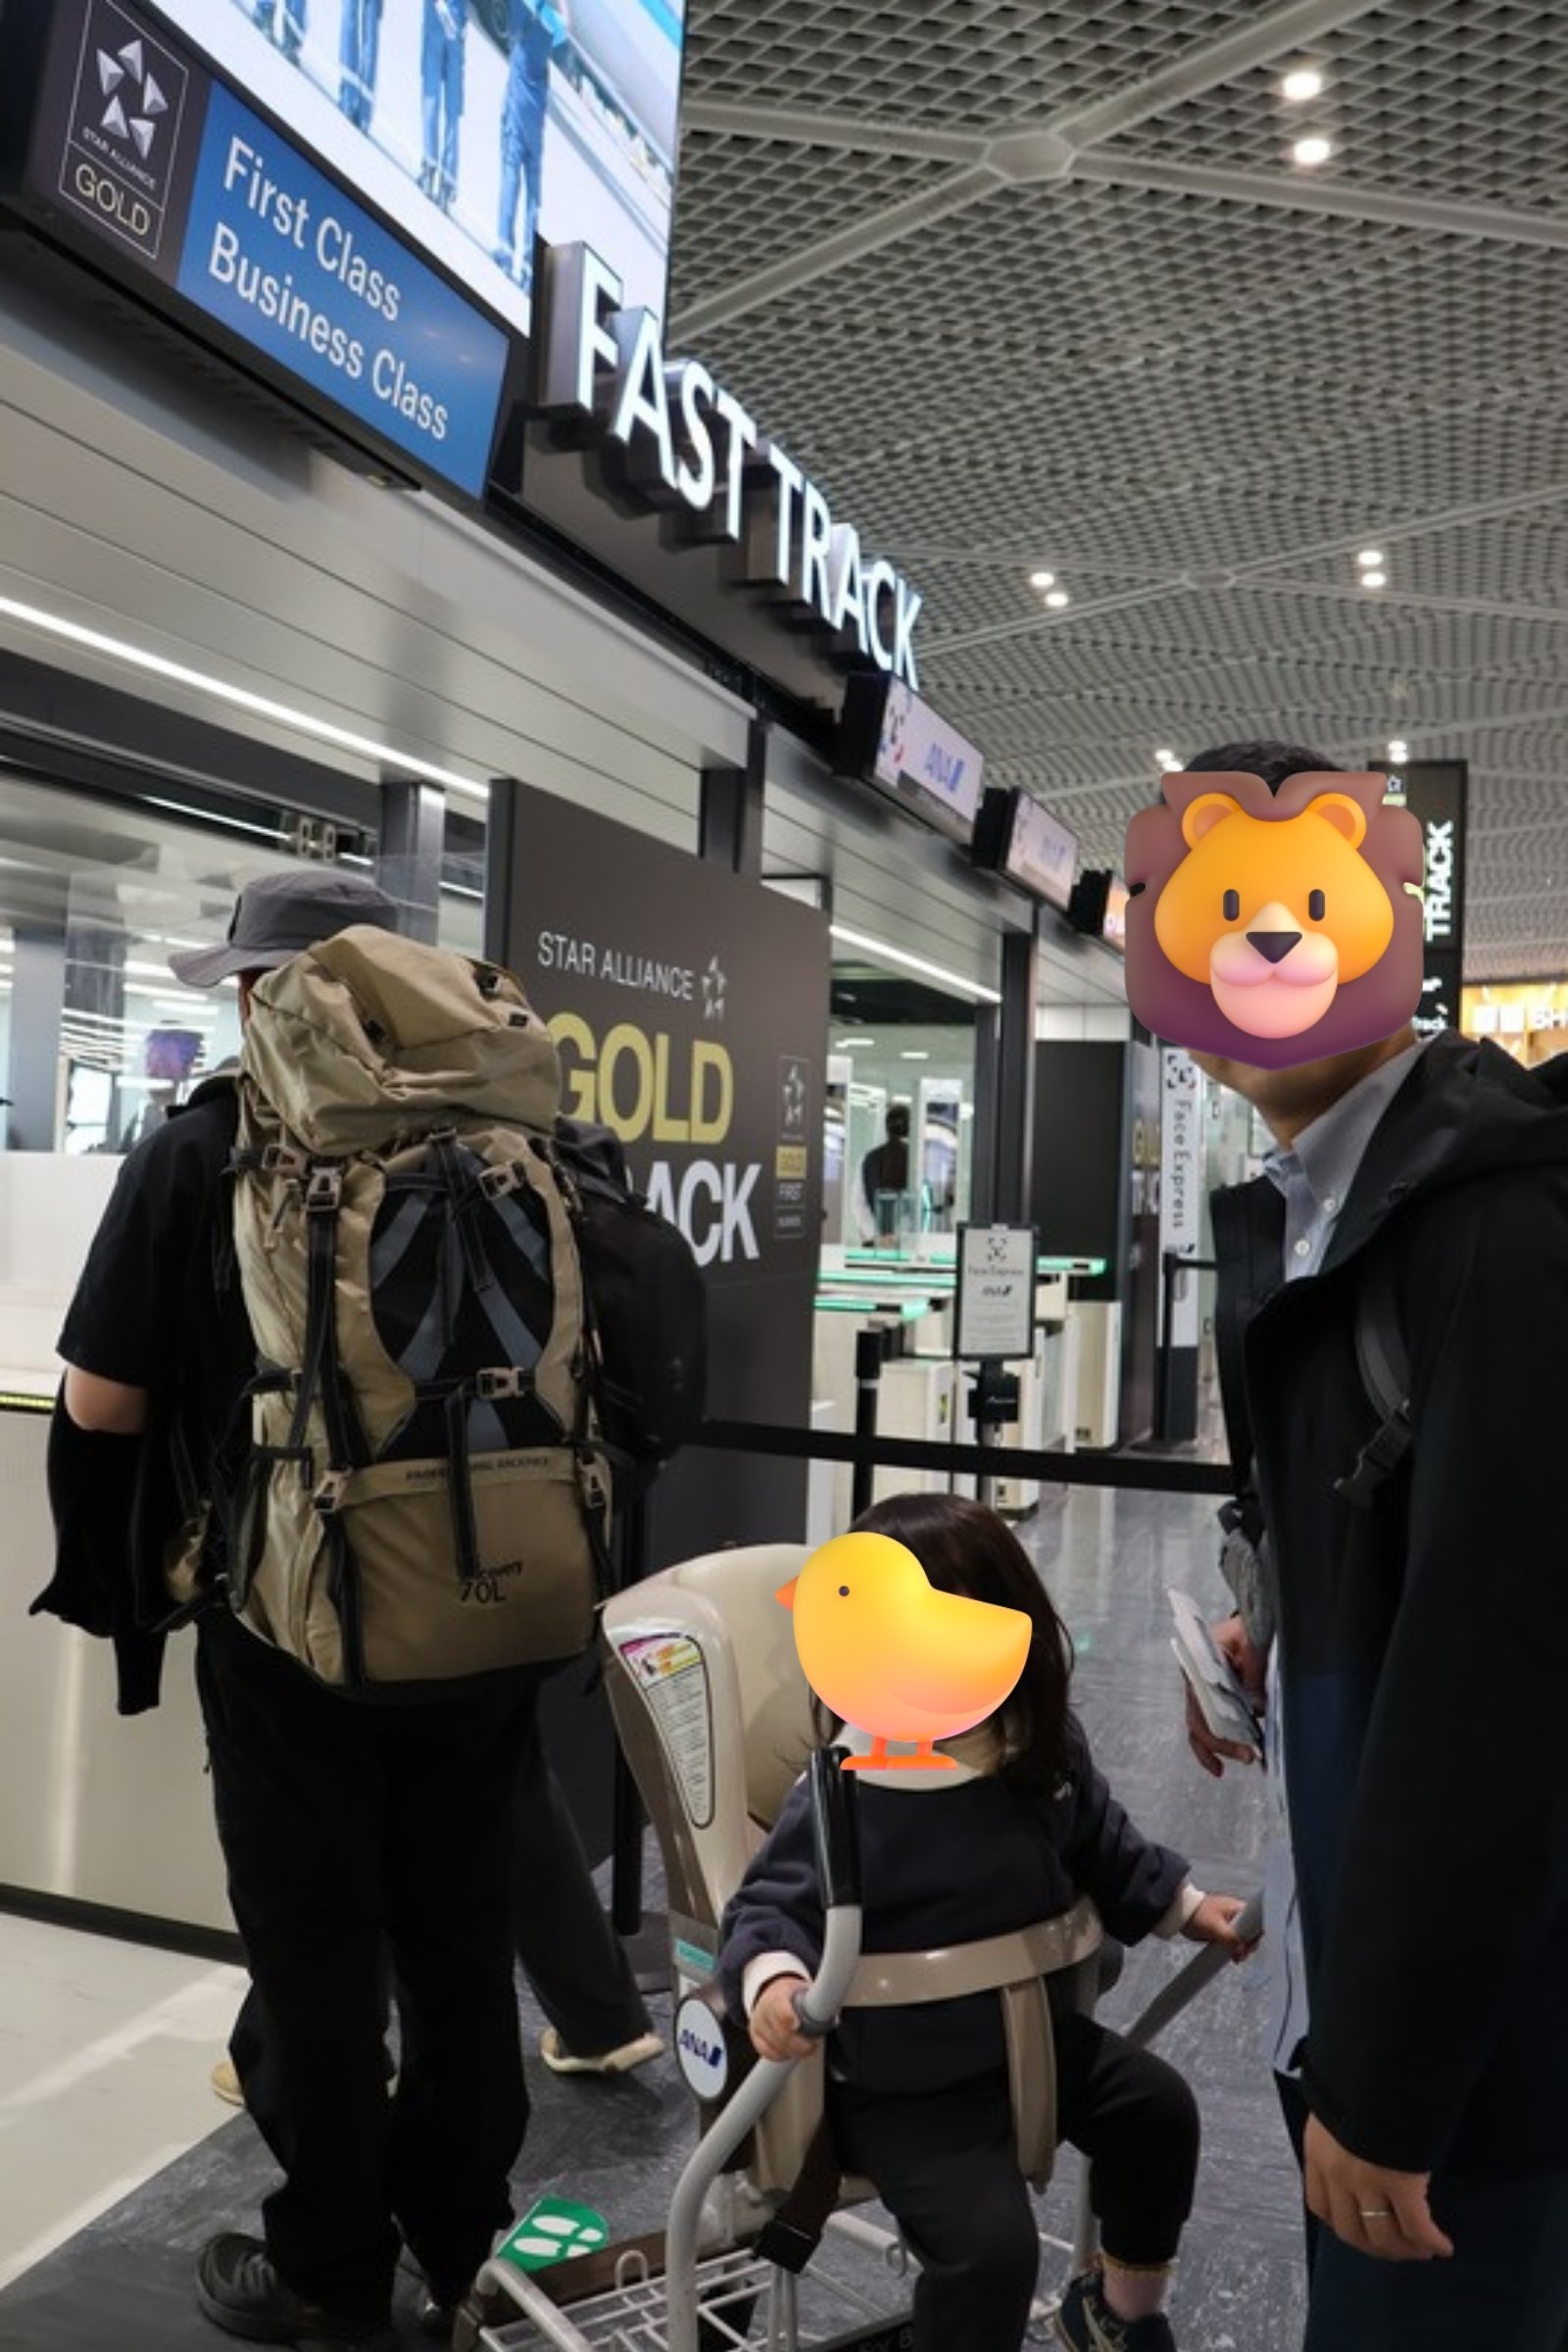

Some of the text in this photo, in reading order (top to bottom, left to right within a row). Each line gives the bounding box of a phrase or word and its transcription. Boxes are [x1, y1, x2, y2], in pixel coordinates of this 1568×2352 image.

[75, 163, 150, 226] GOLD
[223, 134, 401, 321] First Class
[209, 221, 448, 439] Business Class
[576, 243, 924, 692] FAST TRACK
[1426, 819, 1453, 942] TRACK
[538, 931, 694, 1001] STAR ALLIANCE
[545, 1012, 733, 1145] GOLD
[1173, 1099, 1193, 1146] Face
[462, 1581, 507, 1604] 70L
